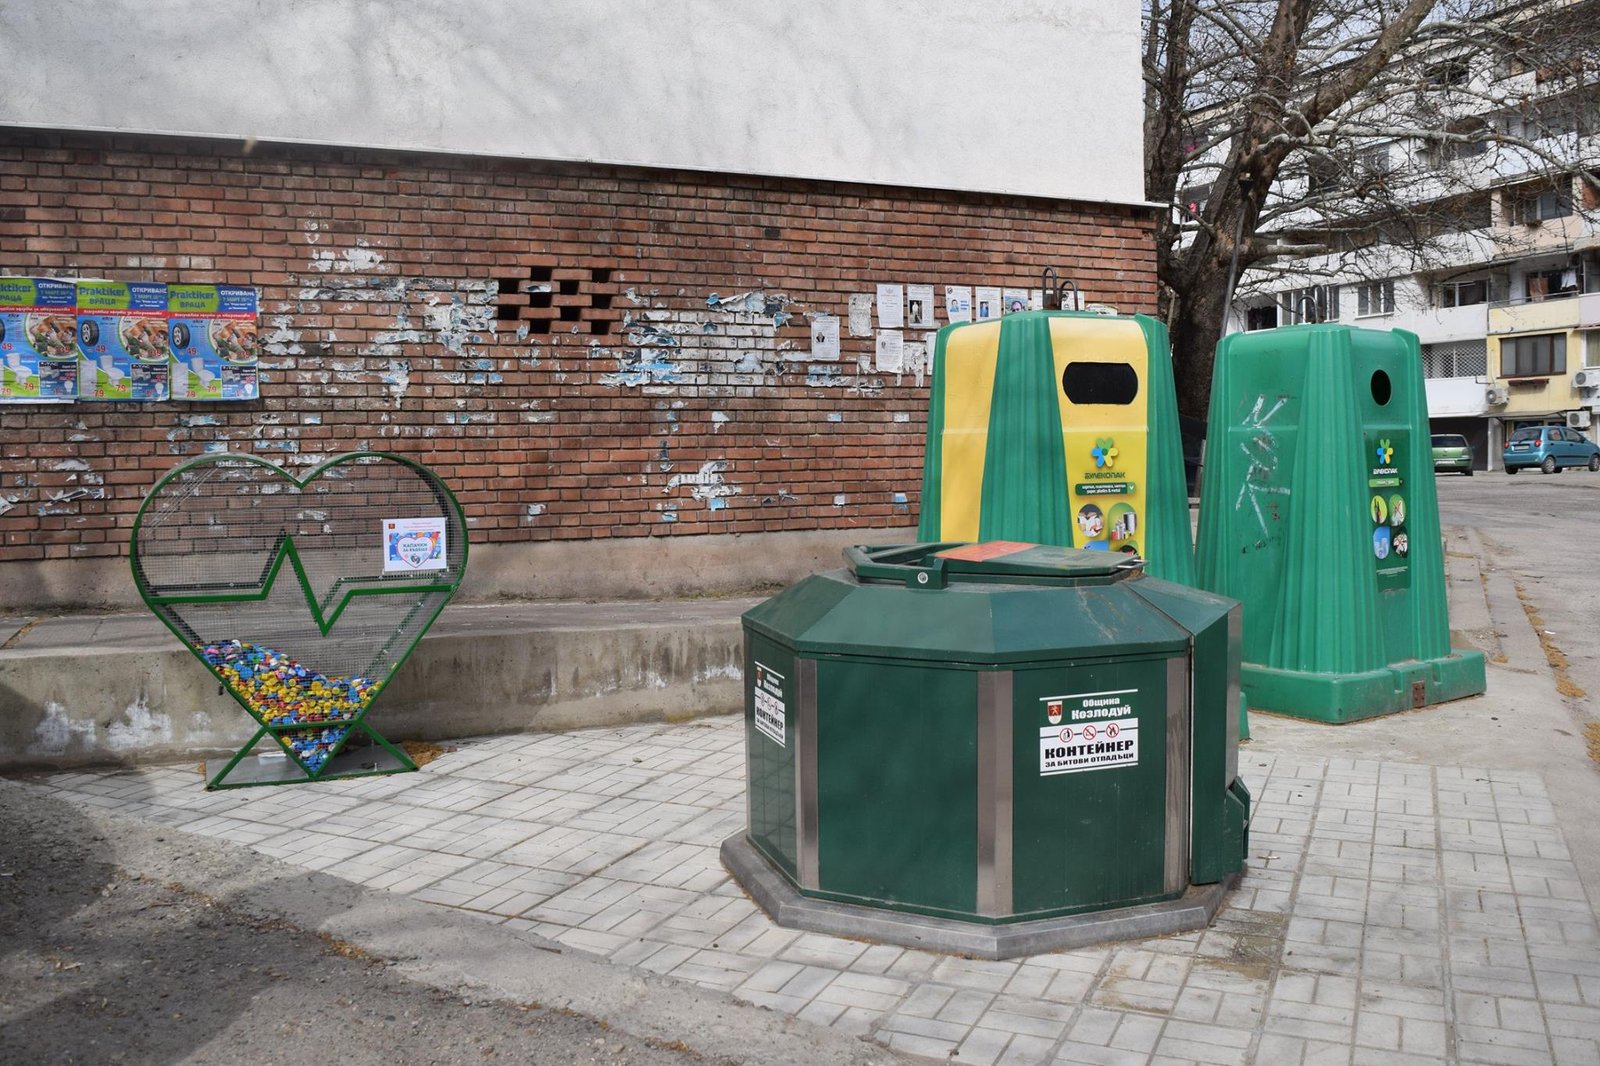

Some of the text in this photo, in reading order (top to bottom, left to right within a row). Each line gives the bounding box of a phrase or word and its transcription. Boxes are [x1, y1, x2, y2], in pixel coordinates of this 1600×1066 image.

[0, 283, 32, 292] ktiker
[79, 287, 125, 296] Praktiker
[170, 290, 214, 299] Praktiker
[116, 384, 126, 392] 79
[94, 390, 104, 398] 79
[1084, 472, 1126, 480] БУЛЕКОПАК
[1082, 698, 1120, 708] Община
[1072, 704, 1131, 720] Козлодуй
[756, 706, 784, 730] КОНТЕЙНЕР
[1044, 740, 1134, 760] КОНТЕЙНЕР
[1058, 757, 1090, 766] БИТОВИ
[1090, 752, 1134, 763] ОТПАДЪЦИ
